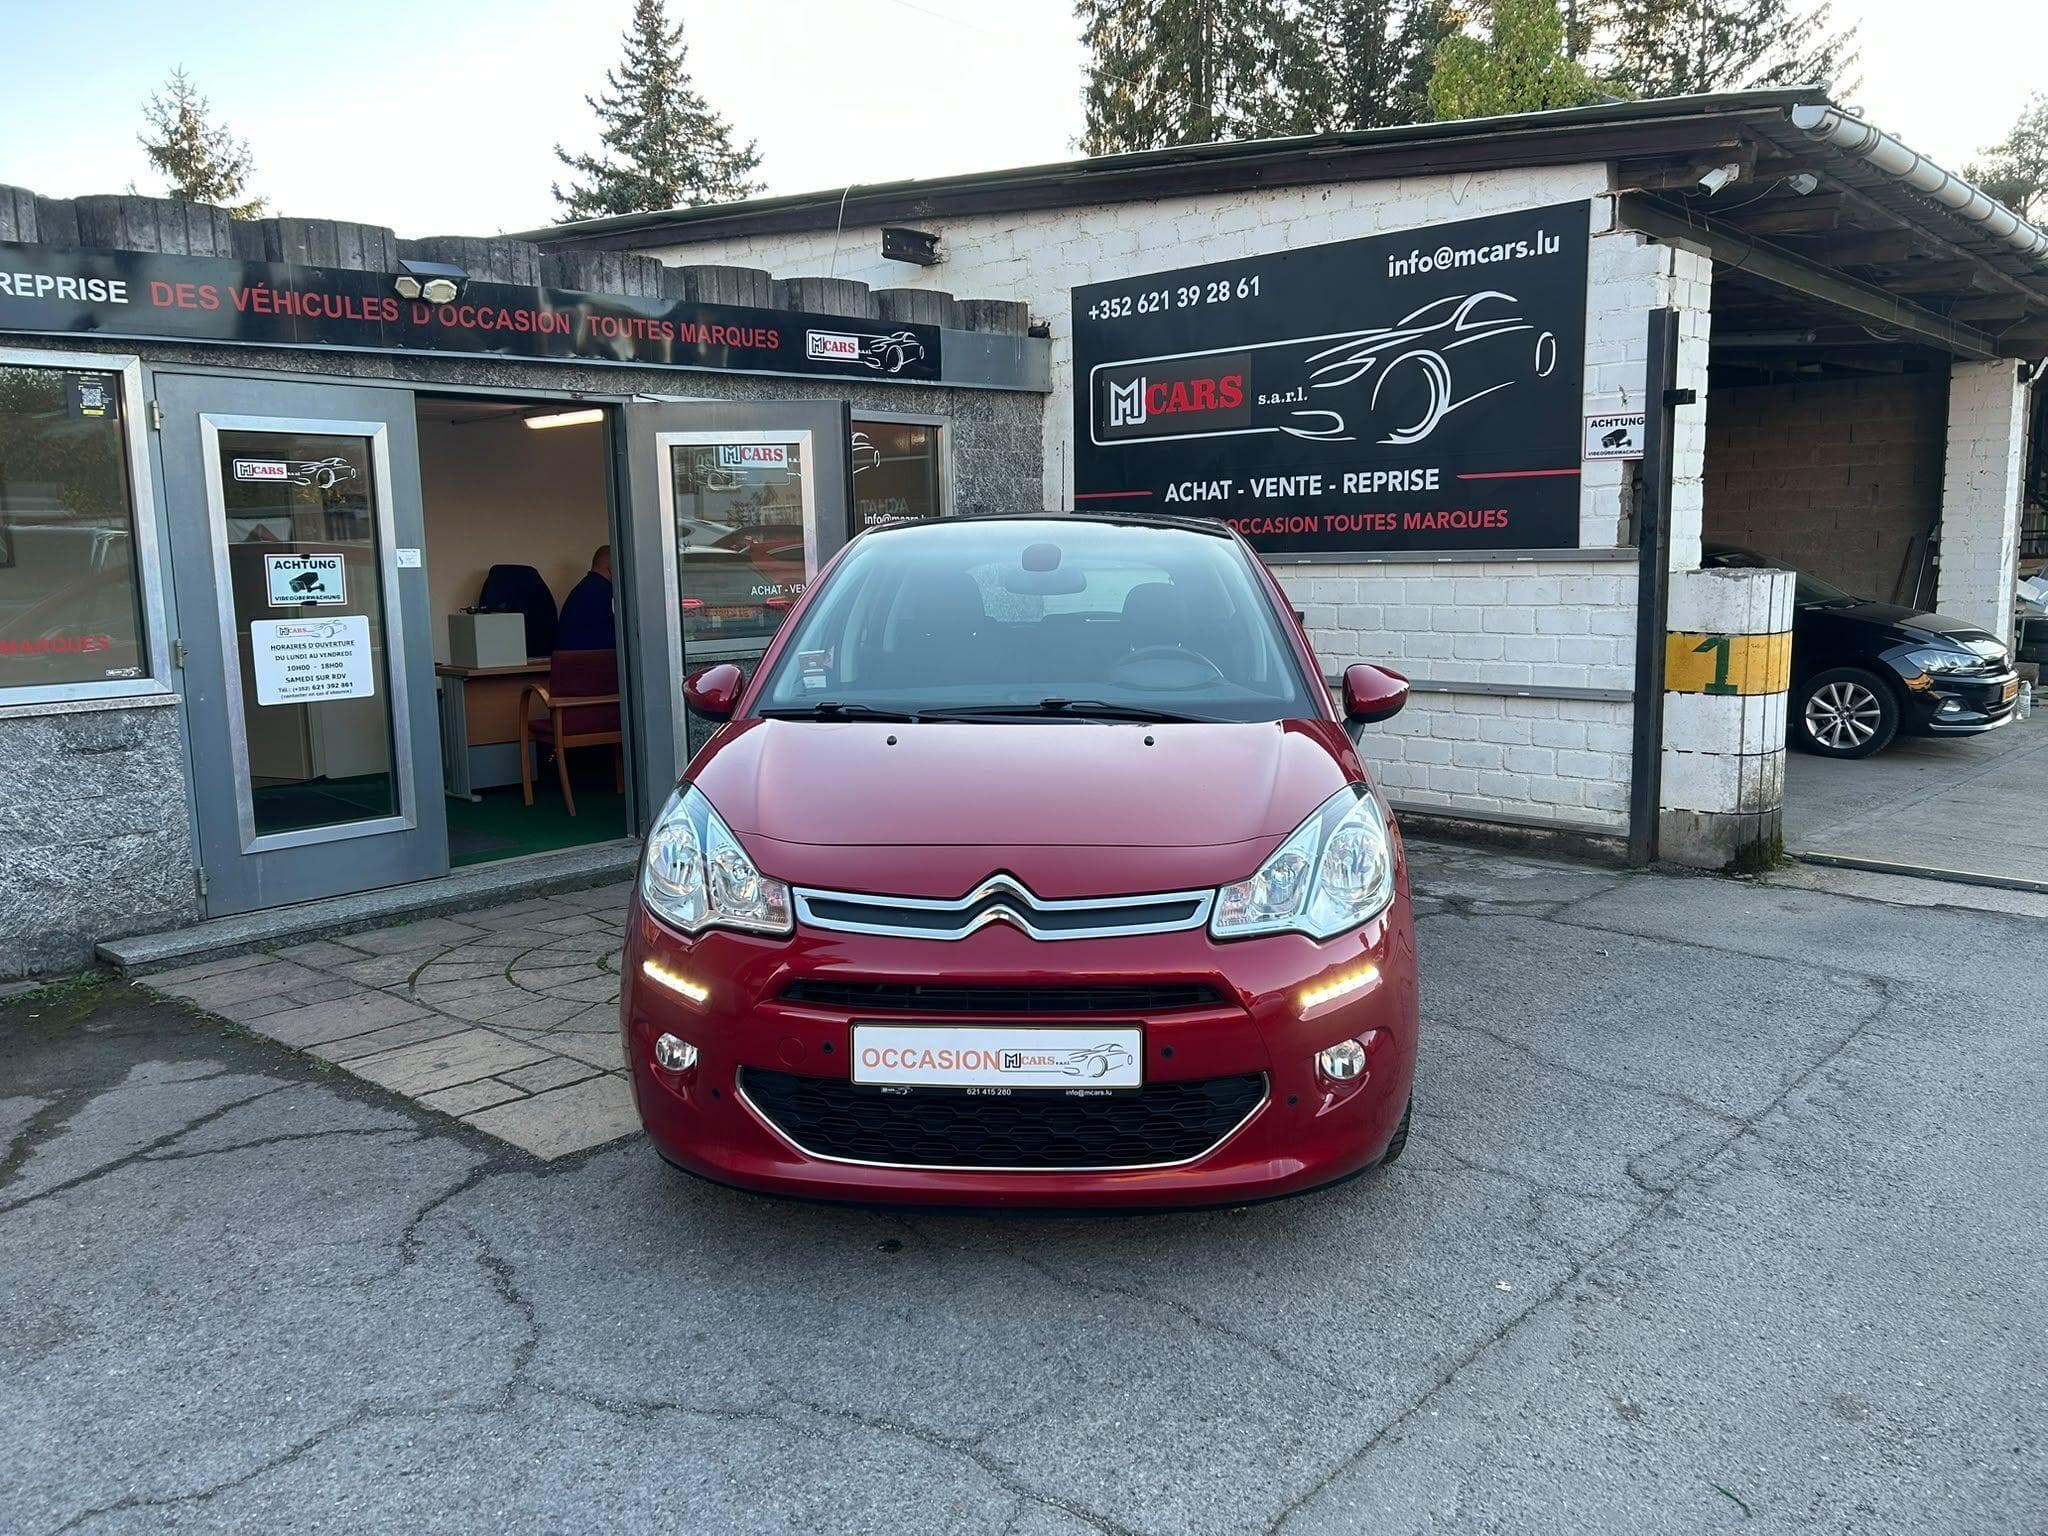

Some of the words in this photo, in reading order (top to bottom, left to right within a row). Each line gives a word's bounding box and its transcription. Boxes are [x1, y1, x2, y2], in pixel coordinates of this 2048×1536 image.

[1388, 229, 1560, 278] info@mcars.lu
[1088, 296, 1132, 321] +352
[1137, 289, 1169, 314] 621
[1177, 285, 1201, 308] 39
[1206, 280, 1231, 304] 28
[1236, 275, 1259, 299] 61
[0, 271, 129, 304] REPRISE
[150, 281, 220, 311] DES
[228, 280, 400, 322] VÉHICULES
[412, 302, 571, 335] D'OCCASION
[587, 315, 675, 341] TOUTES
[681, 322, 780, 350] MARQUES
[1258, 387, 1309, 405] s.a.r.l.
[1590, 416, 1645, 429] ACHTUNG
[1164, 479, 1233, 503] ACHAT
[1250, 474, 1322, 498] VENTE
[1343, 468, 1440, 494] REPRISE
[1324, 513, 1398, 532] TOUTES
[1403, 509, 1509, 530] MARQUES
[274, 560, 337, 570] ACHTUNG
[750, 584, 783, 596] ACHAT
[270, 642, 308, 652] HORAIRES
[286, 653, 308, 661] LUNDI
[309, 651, 319, 659] AU
[319, 649, 353, 659] VENDREDI
[1691, 637, 1738, 695] 1
[285, 674, 314, 683] SAMEDI
[315, 674, 331, 682] SUR
[861, 1048, 1000, 1071] OCCASION
